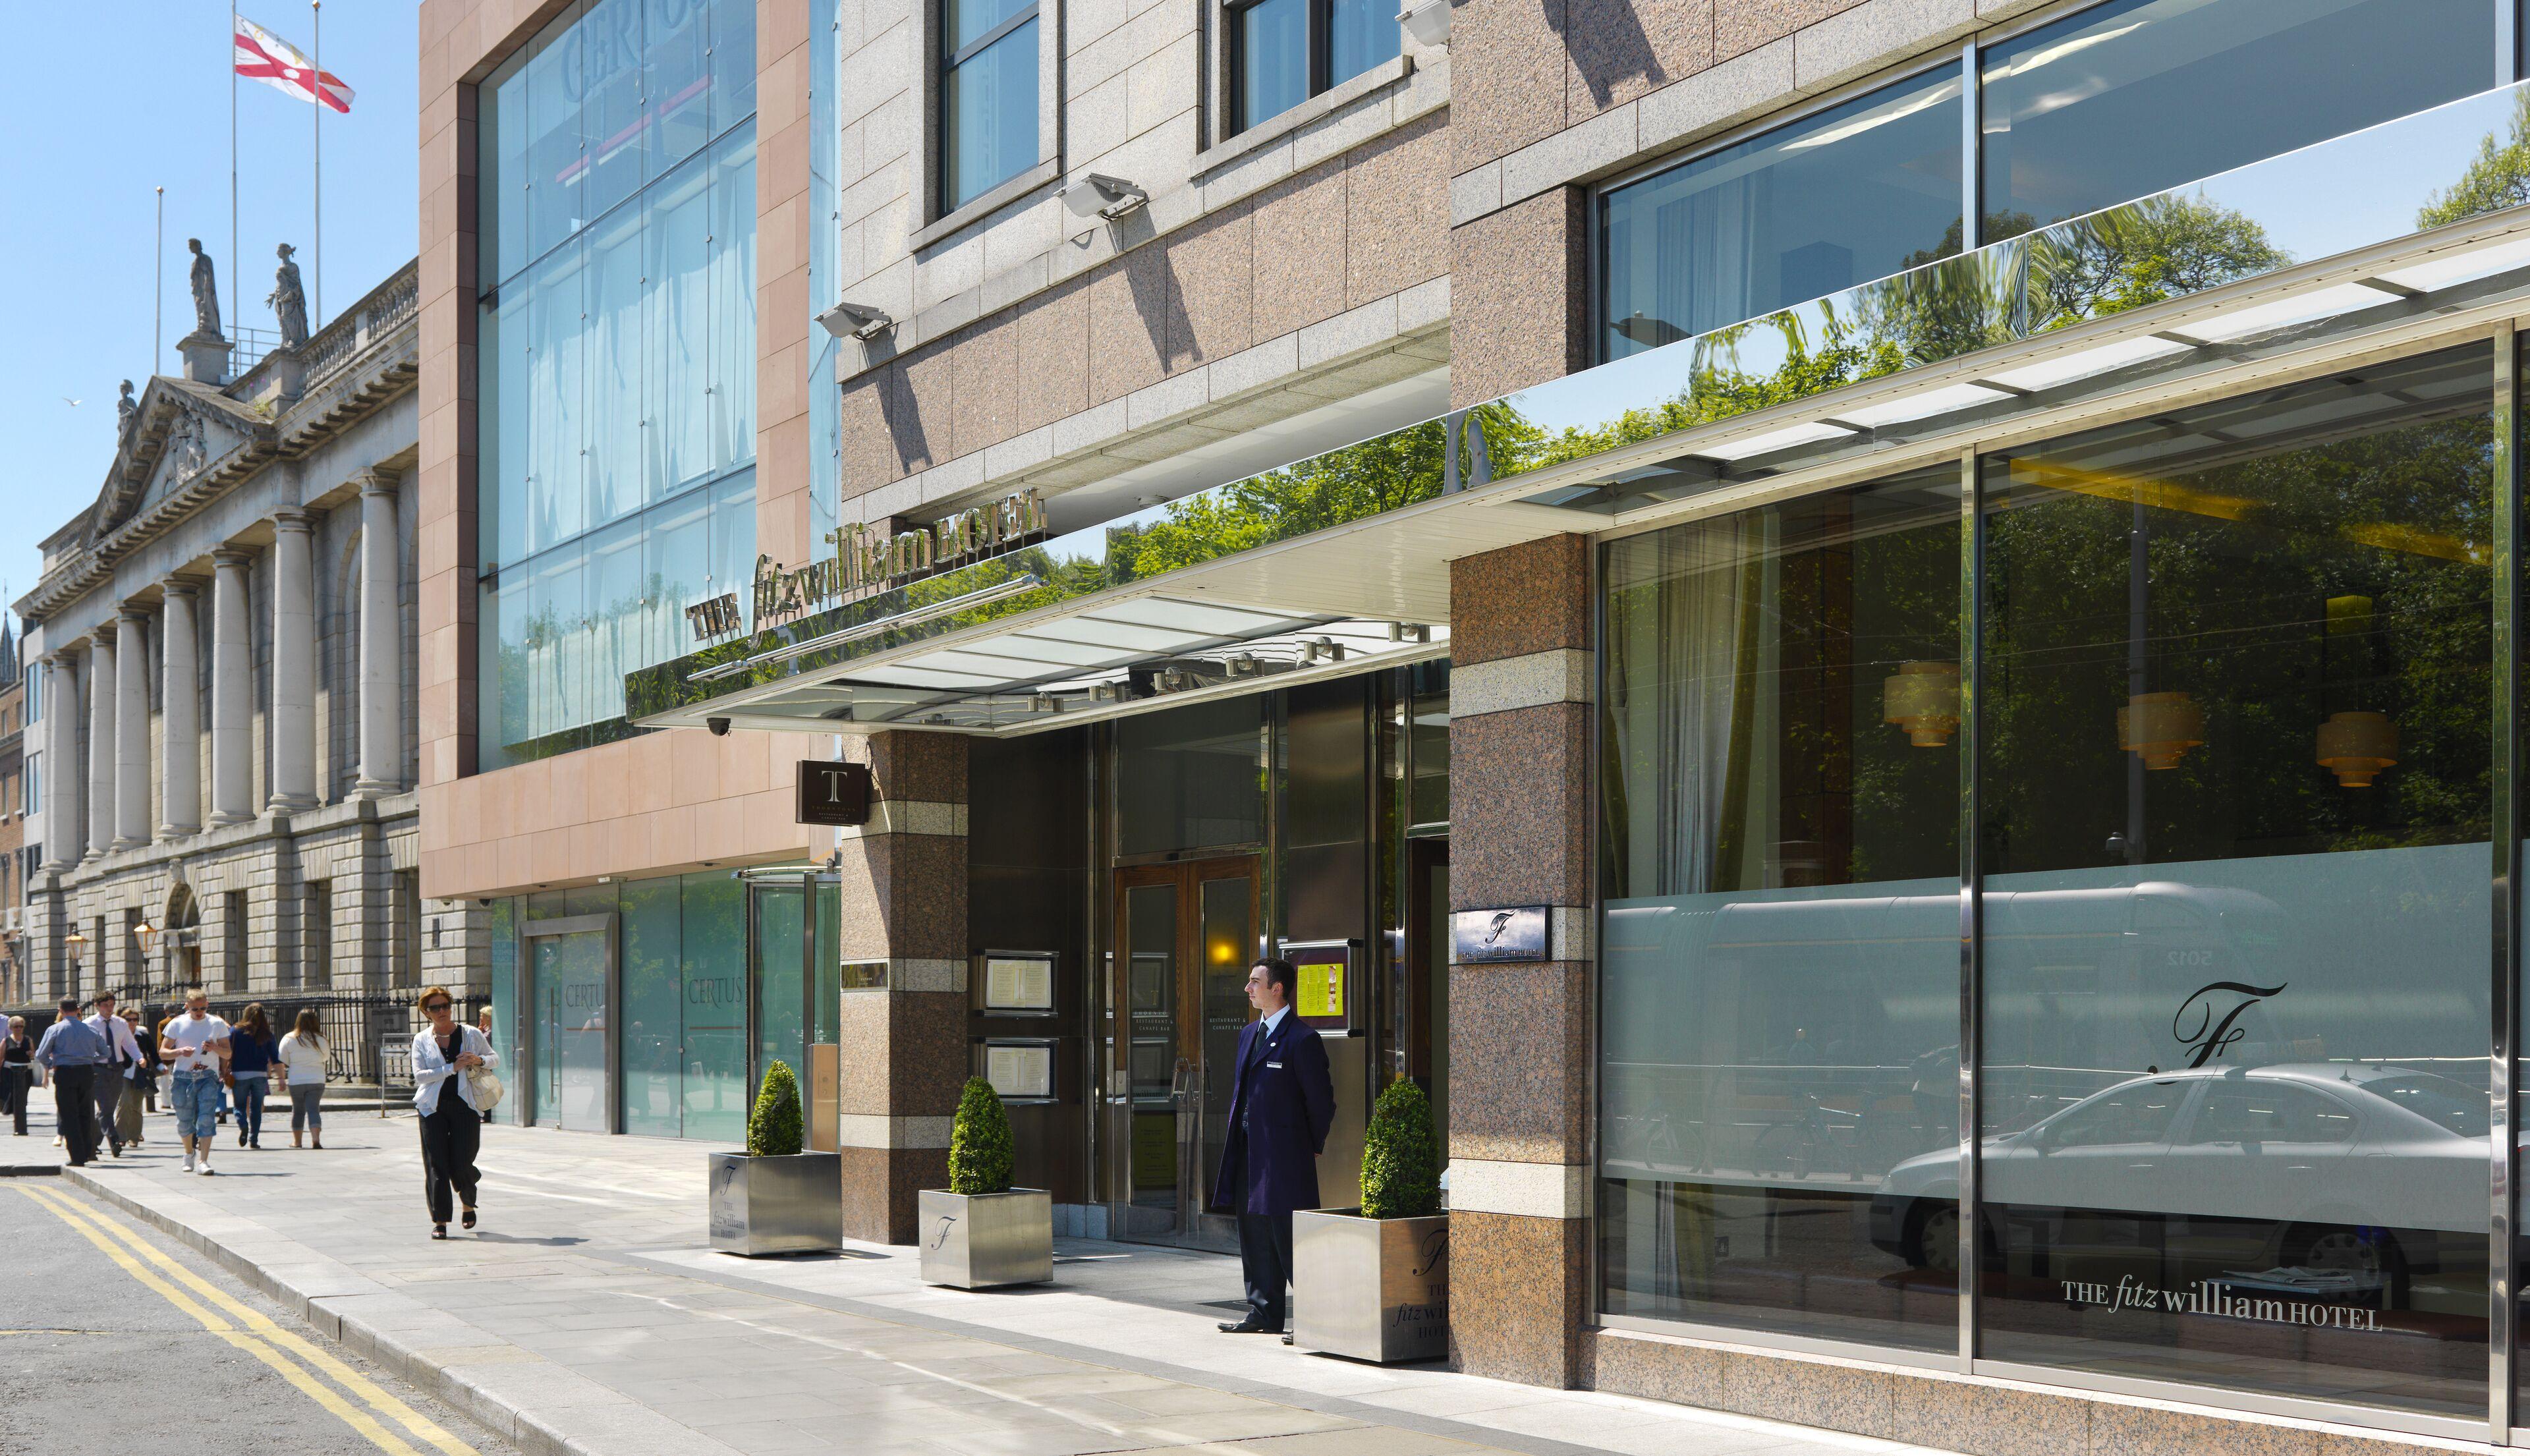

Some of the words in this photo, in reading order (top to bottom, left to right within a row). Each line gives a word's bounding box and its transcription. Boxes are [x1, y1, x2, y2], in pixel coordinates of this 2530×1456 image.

[685, 593, 742, 642] THE
[934, 486, 1048, 563] HOTEL
[821, 770, 847, 802] T
[689, 978, 742, 1009] CERTUS
[723, 1202, 733, 1211] THE
[721, 1229, 737, 1240] HOTEL
[1428, 1283, 1449, 1297] TH
[2062, 1280, 2108, 1304] THE
[2288, 1302, 2383, 1332] HOTEL
[1419, 1324, 1449, 1339] HOT
